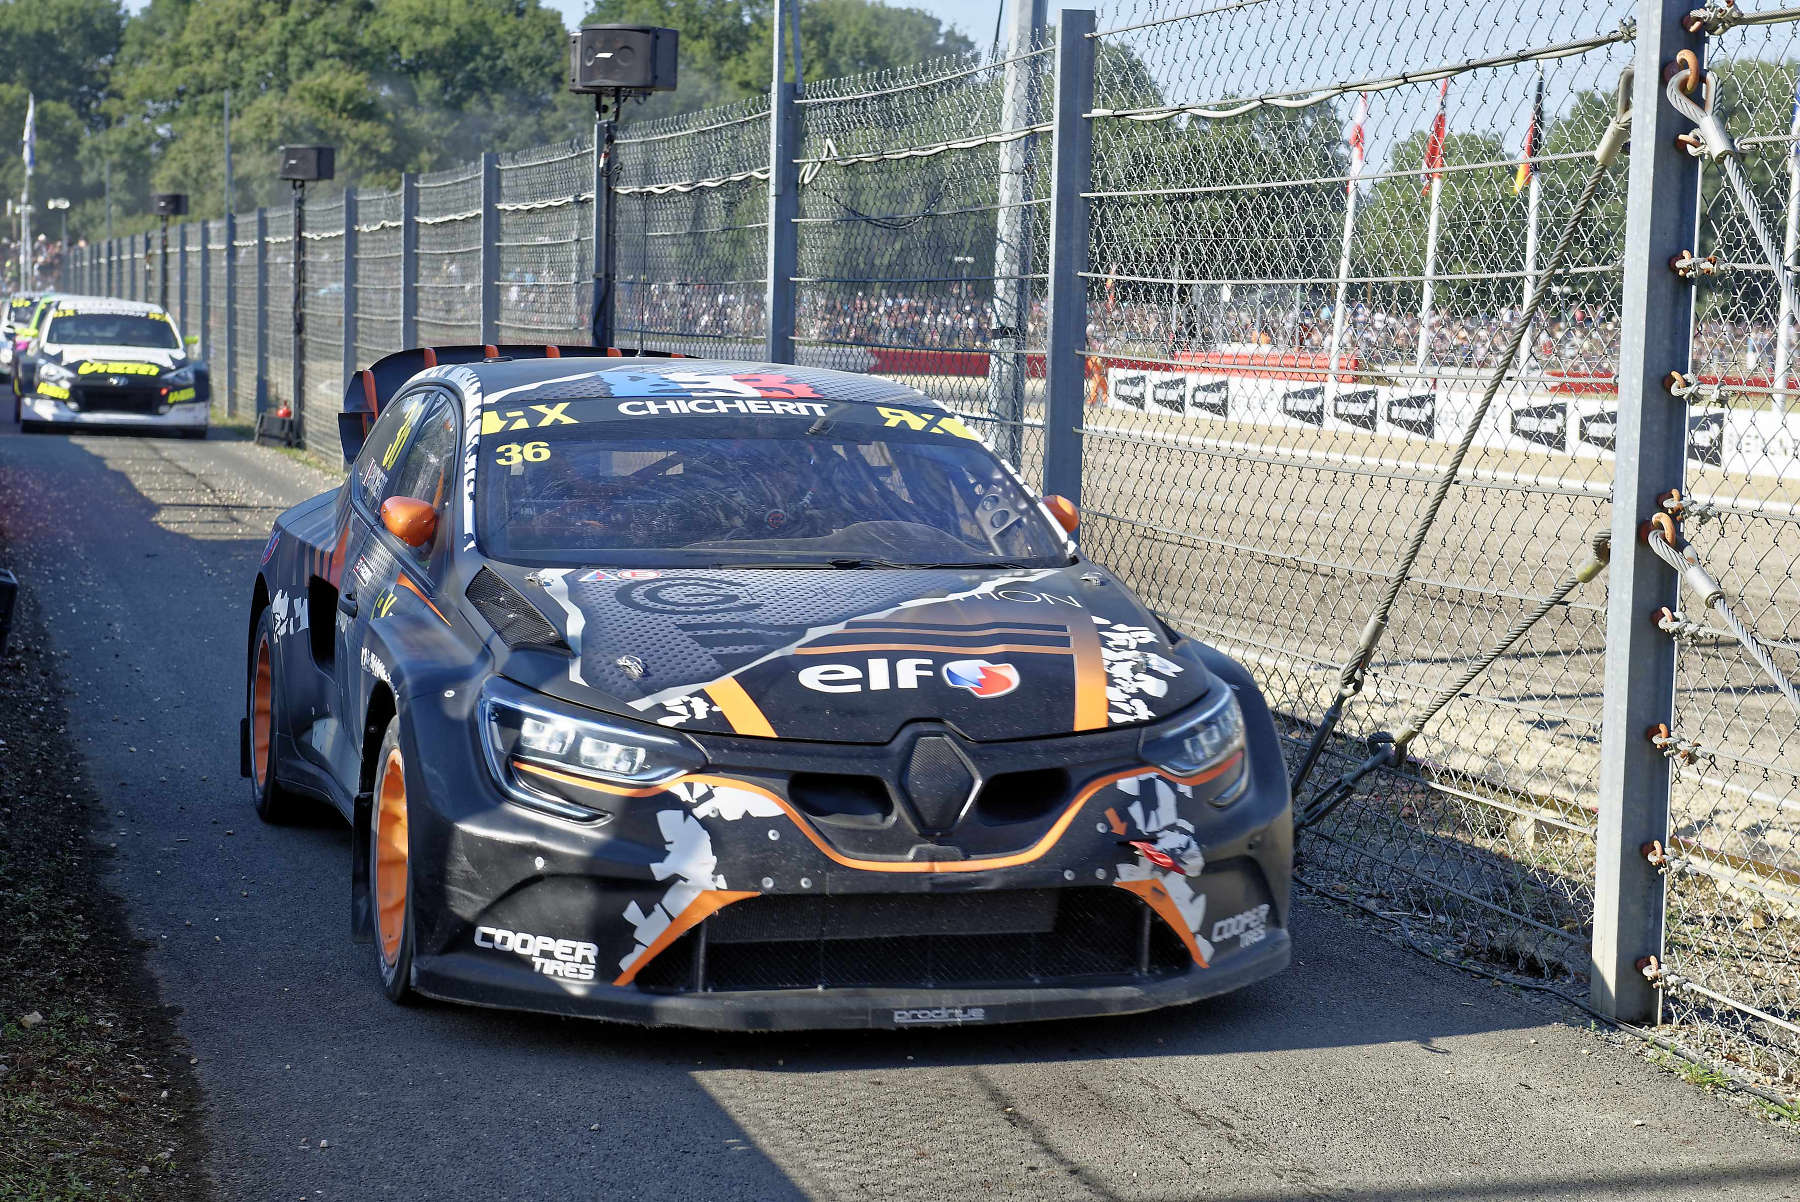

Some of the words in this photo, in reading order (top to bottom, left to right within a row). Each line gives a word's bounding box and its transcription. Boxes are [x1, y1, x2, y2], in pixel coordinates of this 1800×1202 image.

[617, 399, 829, 417] CHICHERIT
[495, 441, 551, 466] 36
[798, 657, 934, 694] elf
[1211, 903, 1270, 943] COOPER
[474, 926, 599, 964] COOPER
[532, 956, 596, 980] TIRES
